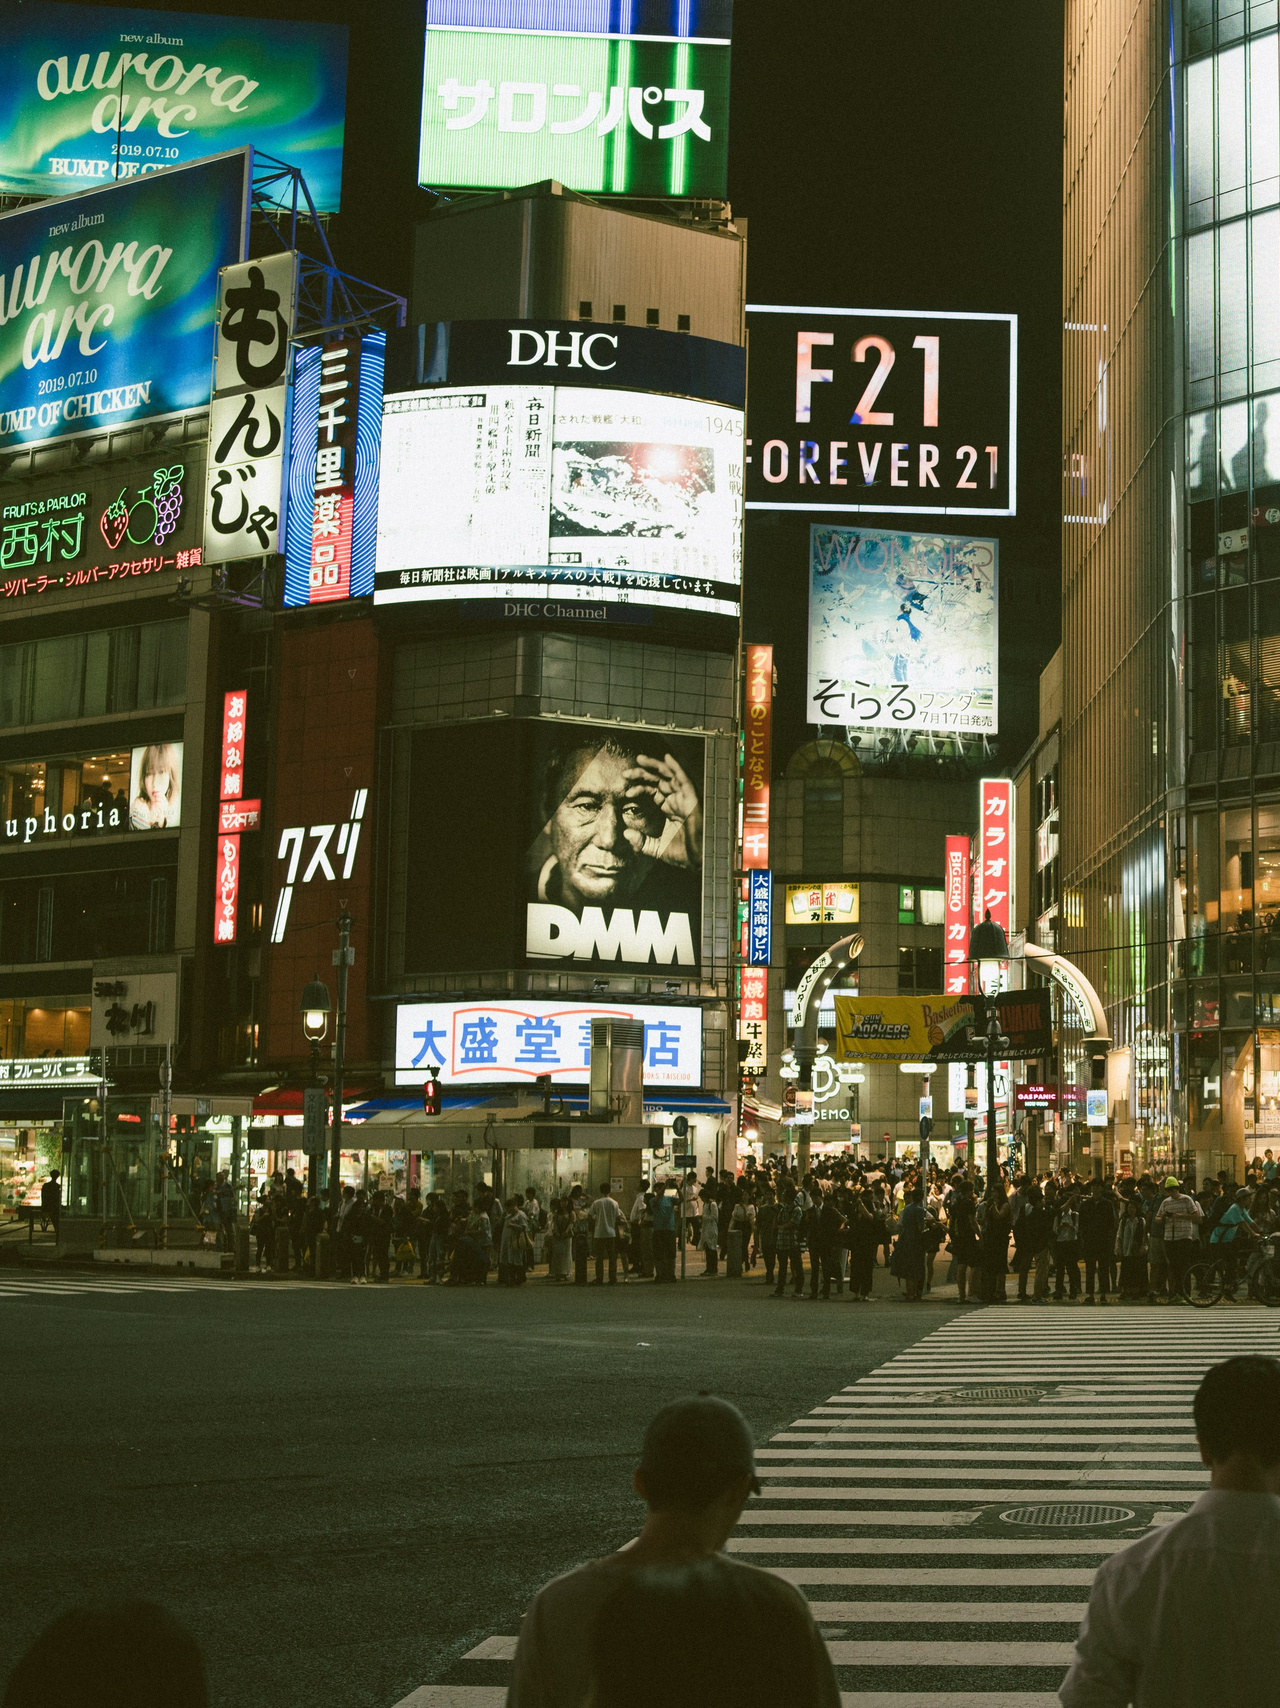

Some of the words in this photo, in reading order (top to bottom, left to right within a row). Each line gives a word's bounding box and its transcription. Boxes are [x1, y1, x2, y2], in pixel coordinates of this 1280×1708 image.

[120, 33, 143, 43] new
[146, 33, 184, 46] album
[37, 51, 259, 113] aurora
[91, 94, 196, 138] arc
[437, 77, 711, 142] サロンパス
[49, 157, 108, 177] BUMP
[111, 144, 179, 159] 2019.07.10
[48, 221, 68, 237] new
[70, 213, 105, 231] album
[0, 240, 173, 326] urora
[22, 301, 115, 370] arc
[507, 329, 618, 371] DHC
[38, 368, 98, 395] 2019.07.10
[795, 331, 940, 427] F21
[38, 403, 61, 428] OF
[61, 380, 152, 422] CHICKEN
[211, 266, 288, 549] もんじゃ
[706, 416, 743, 437] 1945
[309, 348, 349, 587] 三千里薬品
[956, 445, 998, 489] 21
[1, 513, 85, 569] 西村
[815, 532, 993, 581] WONDER
[503, 603, 540, 618] DHC
[543, 604, 607, 620] Channel
[749, 652, 768, 790] クスリのことなら
[813, 678, 916, 721] そらる
[919, 691, 993, 709] ワンダー
[919, 711, 993, 727] 7月17日発売
[223, 696, 244, 795] お好み焼
[6, 801, 120, 843] uphoria
[744, 802, 768, 857] 三千
[949, 852, 962, 876] BIG
[985, 797, 1007, 907] カラオケ
[218, 840, 237, 942] もんじゃ焼
[809, 892, 837, 906] 麻雀
[949, 877, 962, 912] ECHO
[526, 902, 696, 966] DMM
[753, 875, 769, 961] 大盛堂商事ビル
[948, 923, 966, 994] カラオ
[794, 956, 827, 1024] 渋谷センター街
[849, 1014, 910, 1040] ROCKERS
[864, 1014, 881, 1023] SUN
[663, 1072, 691, 1081] TAISEIDO
[813, 1109, 850, 1120] DEMO
